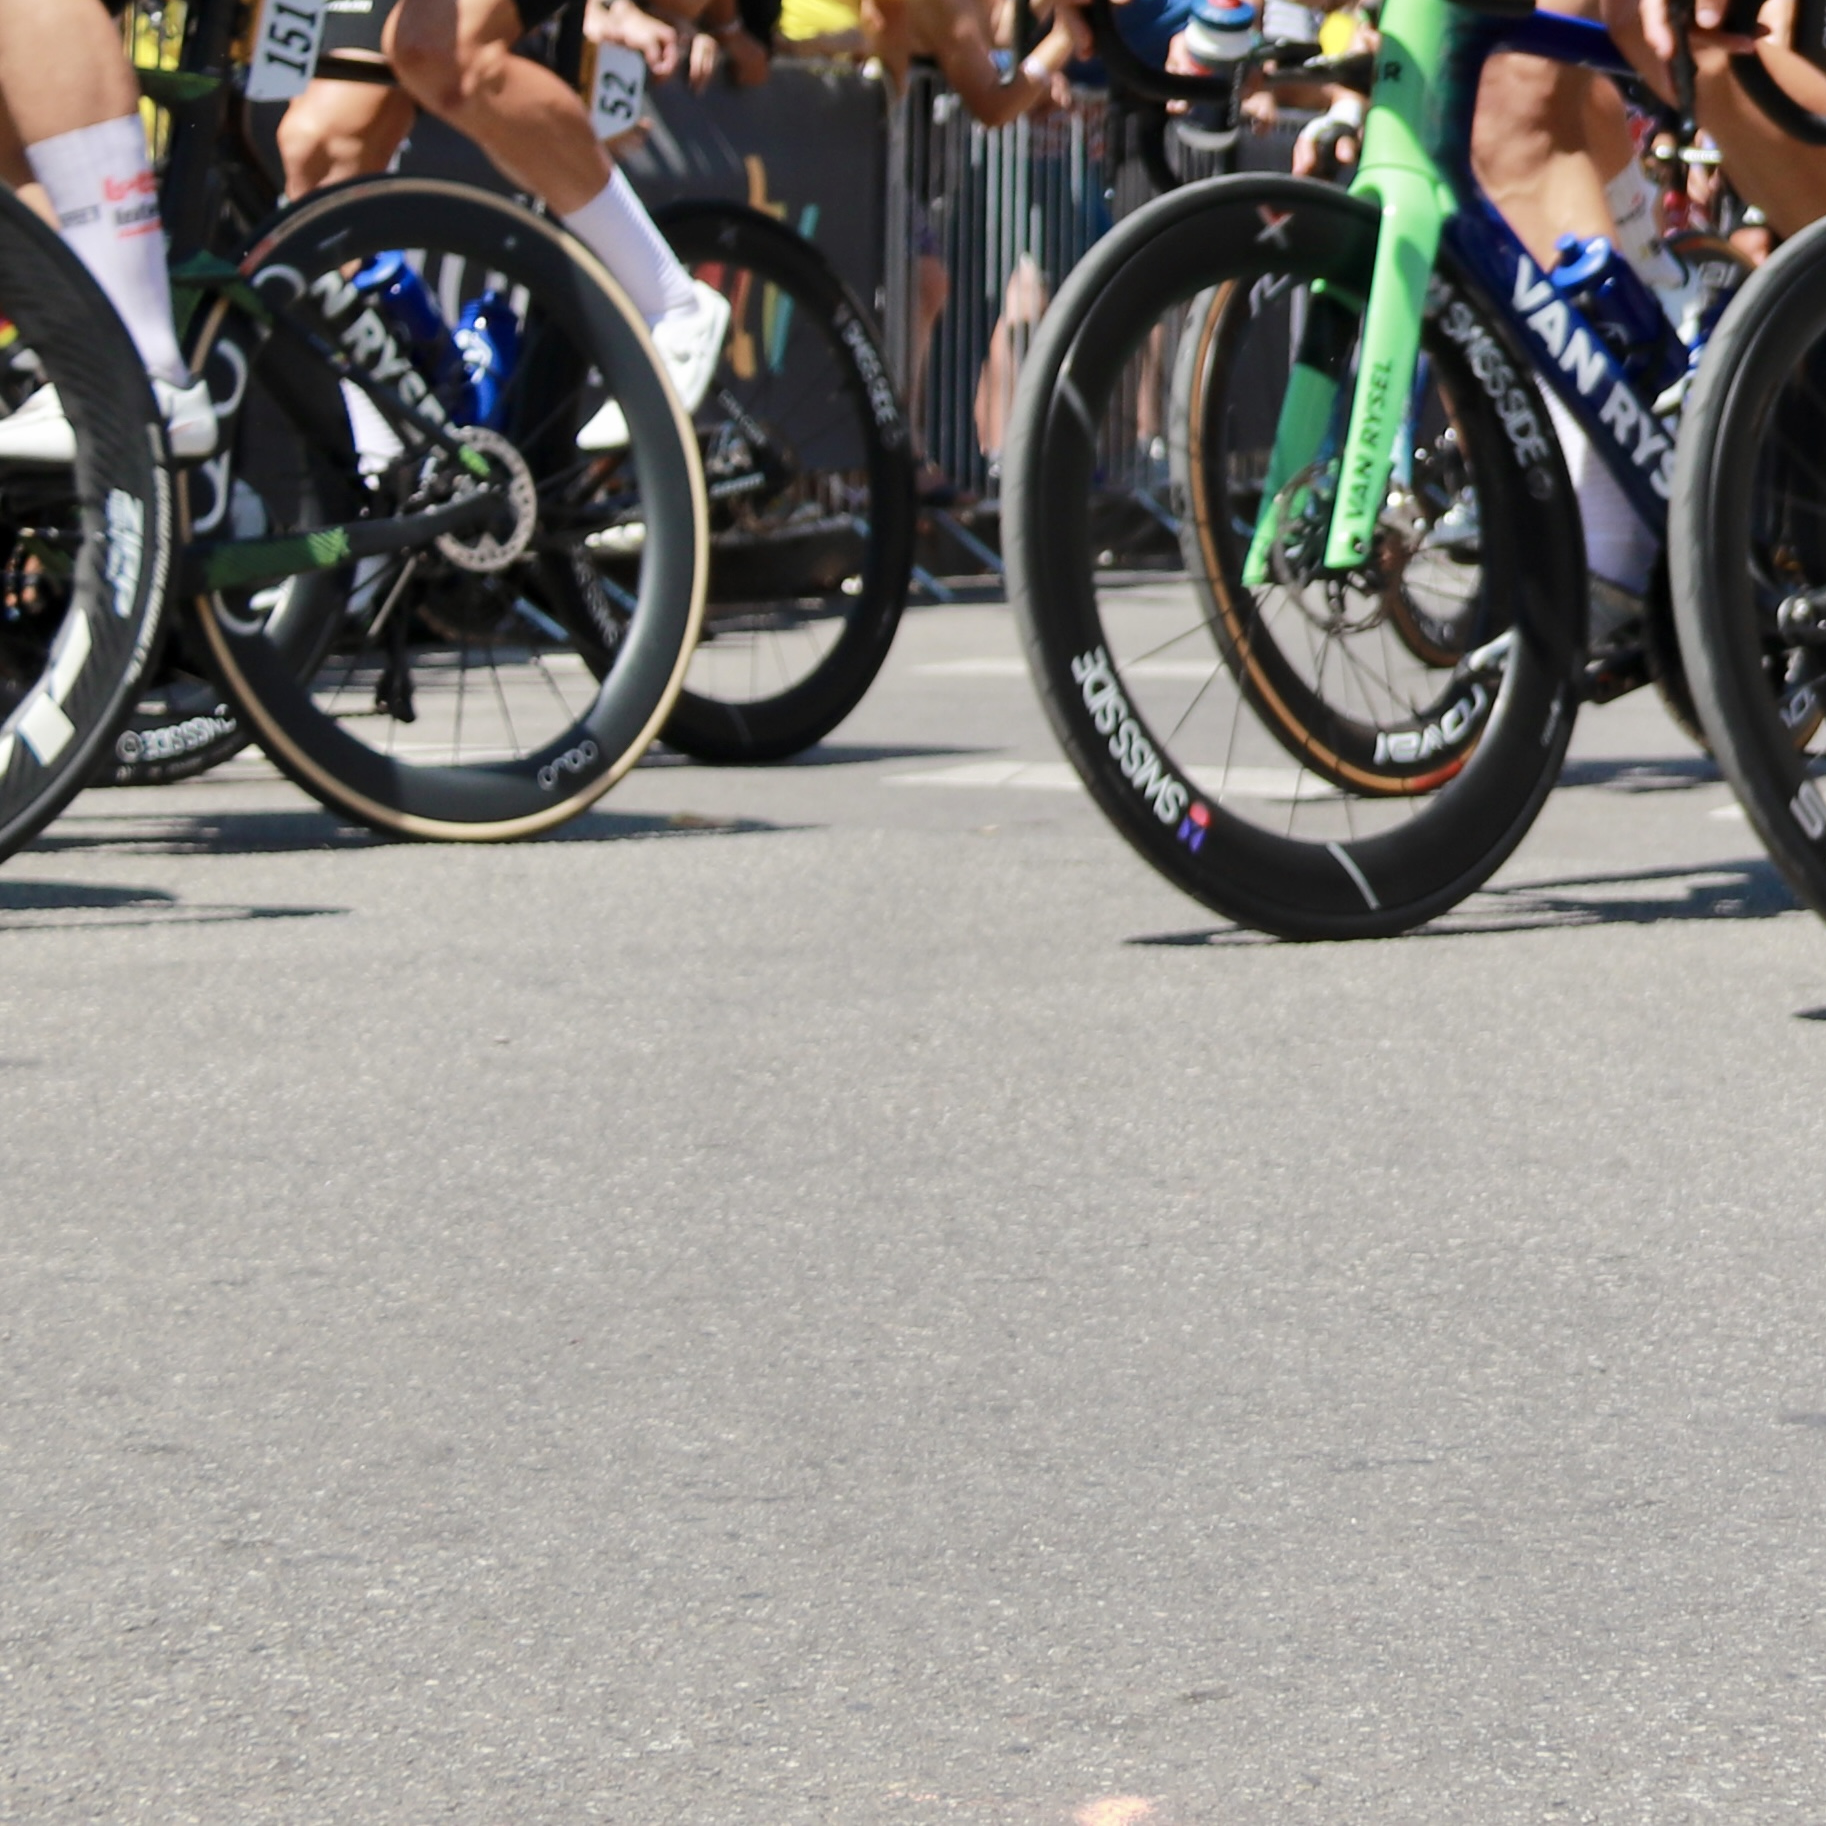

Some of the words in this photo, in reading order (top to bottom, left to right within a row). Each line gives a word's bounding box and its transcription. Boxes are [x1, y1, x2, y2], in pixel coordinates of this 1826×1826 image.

[265, 3, 318, 77] 151
[601, 66, 638, 121] 52
[1513, 252, 1608, 396] VAN
[1357, 357, 1393, 448] RYSEL
[1342, 454, 1375, 520] VAN
